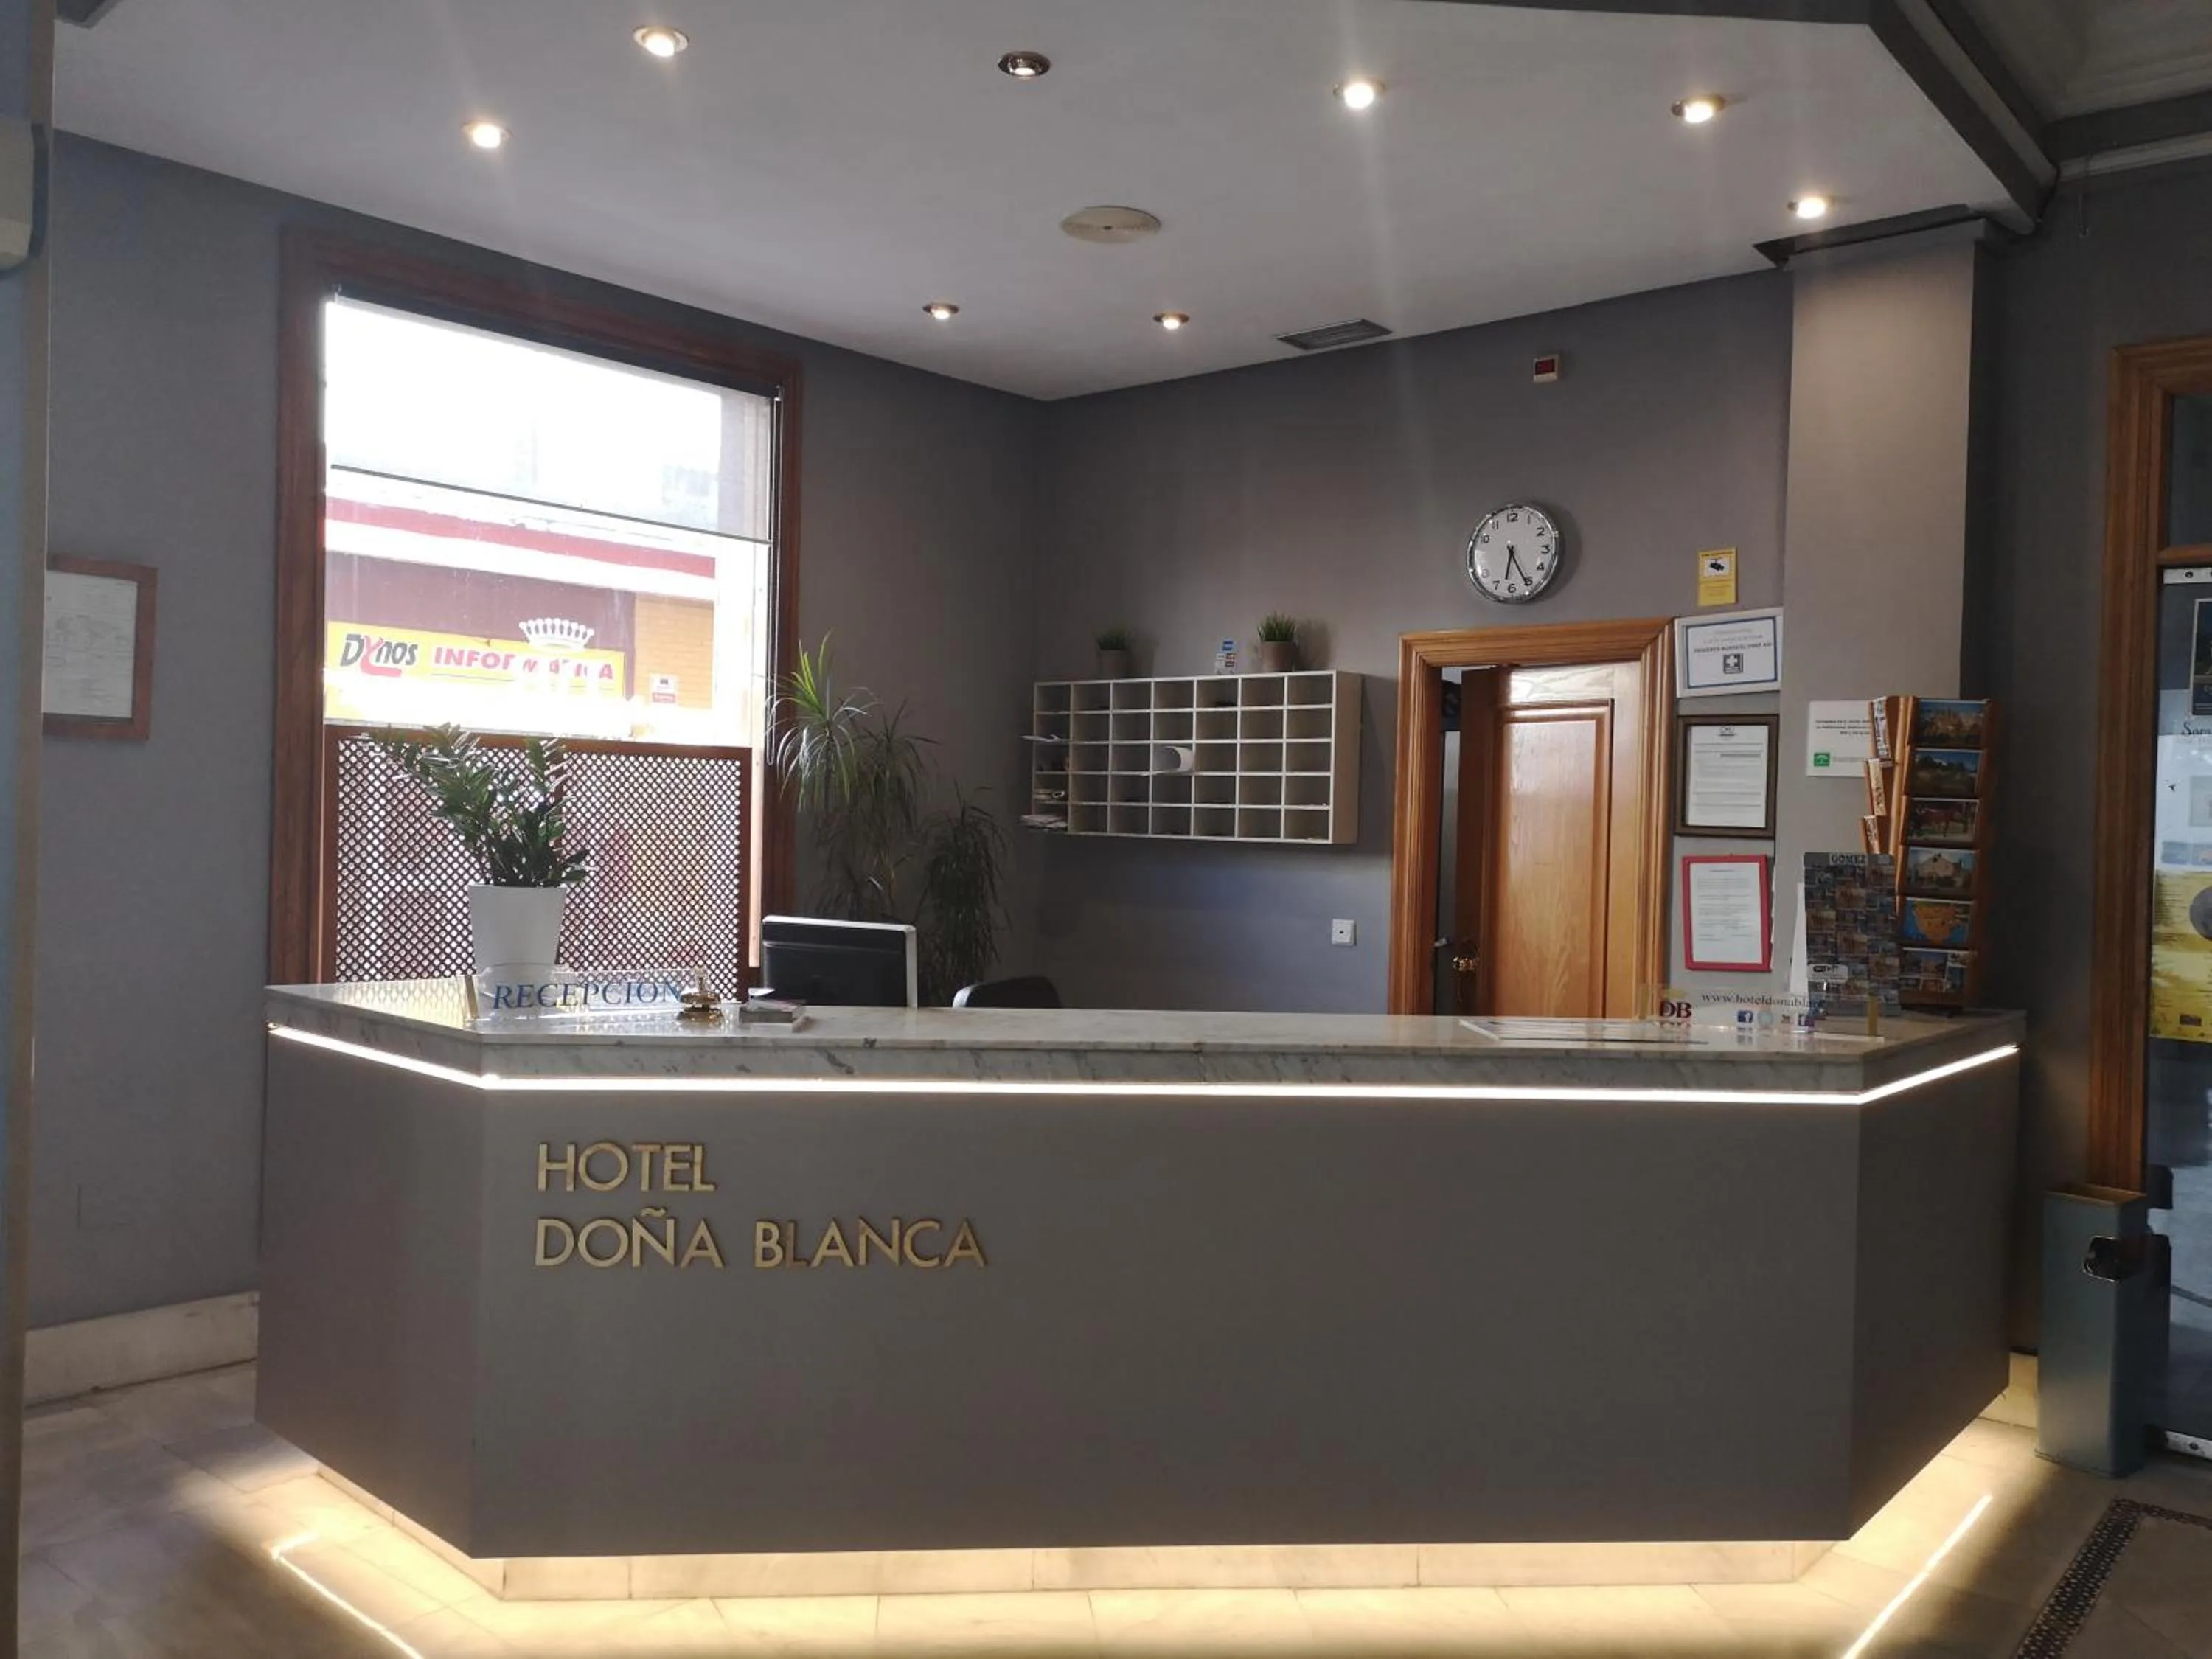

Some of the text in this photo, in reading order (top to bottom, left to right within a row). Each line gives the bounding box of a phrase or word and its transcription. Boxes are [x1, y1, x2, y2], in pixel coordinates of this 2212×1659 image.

[1507, 512, 1518, 522] 12
[1492, 520, 1499, 529] 11
[1536, 527, 1545, 537] 2
[1541, 545, 1550, 554] 3
[1536, 562, 1545, 571] 4
[1492, 580, 1500, 590] 7
[1507, 584, 1516, 593] 6
[1660, 1001, 1693, 1019] DB
[538, 1142, 717, 1193] HOTEL
[535, 1206, 987, 1269] DOÑA BLANCA
